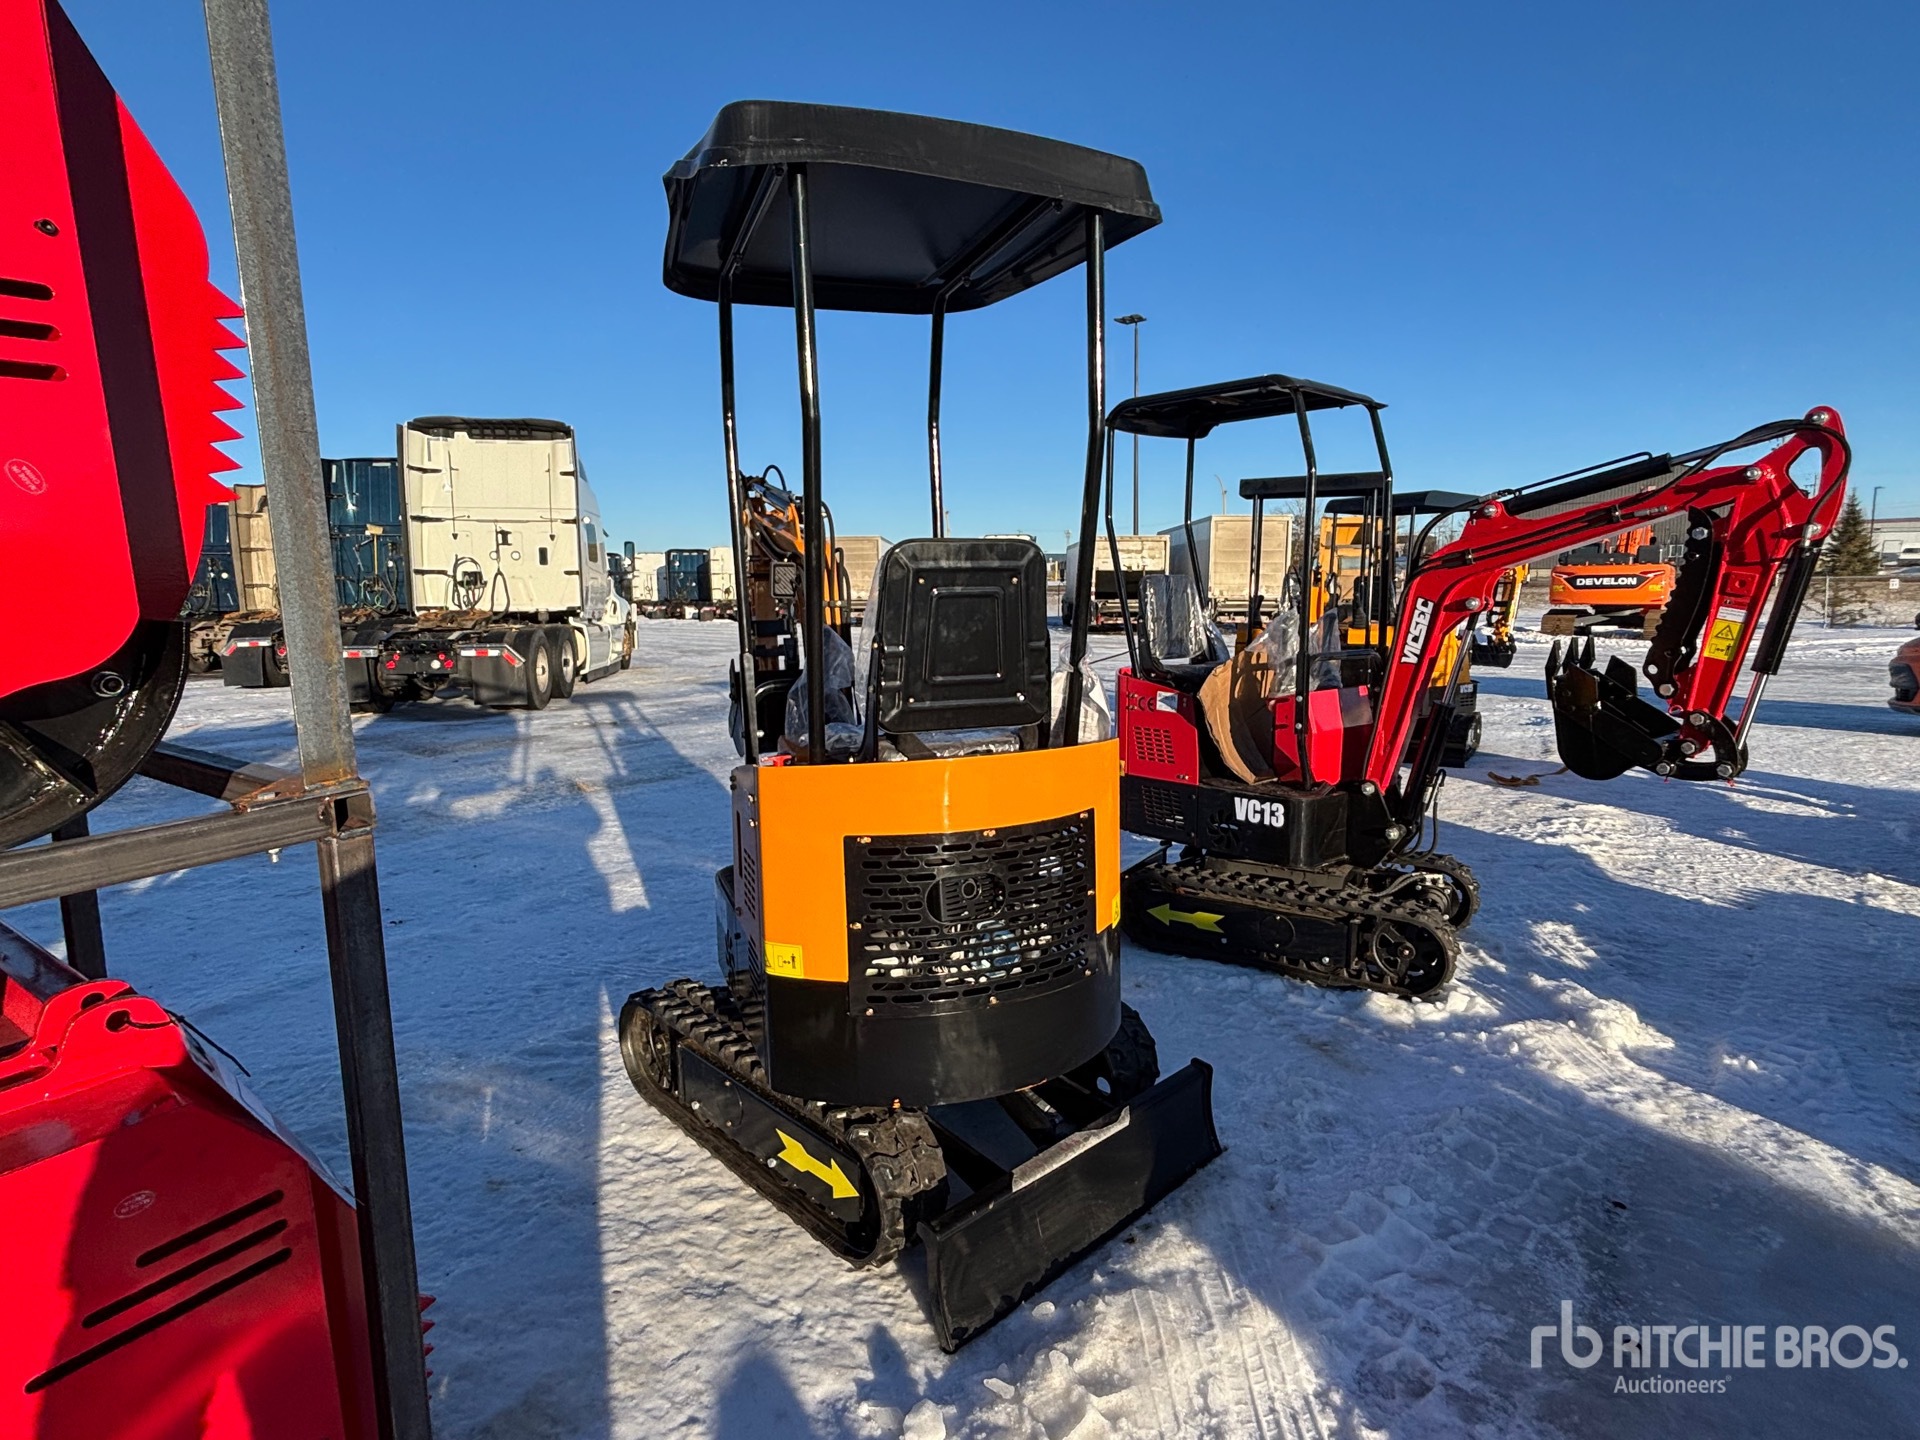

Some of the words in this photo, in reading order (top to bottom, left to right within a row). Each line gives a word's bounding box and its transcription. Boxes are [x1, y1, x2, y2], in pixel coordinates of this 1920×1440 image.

[21, 465, 40, 485] CHINA
[1576, 577, 1637, 586] DEVELON
[1401, 597, 1434, 664] VICSEC
[1234, 797, 1285, 828] VC13
